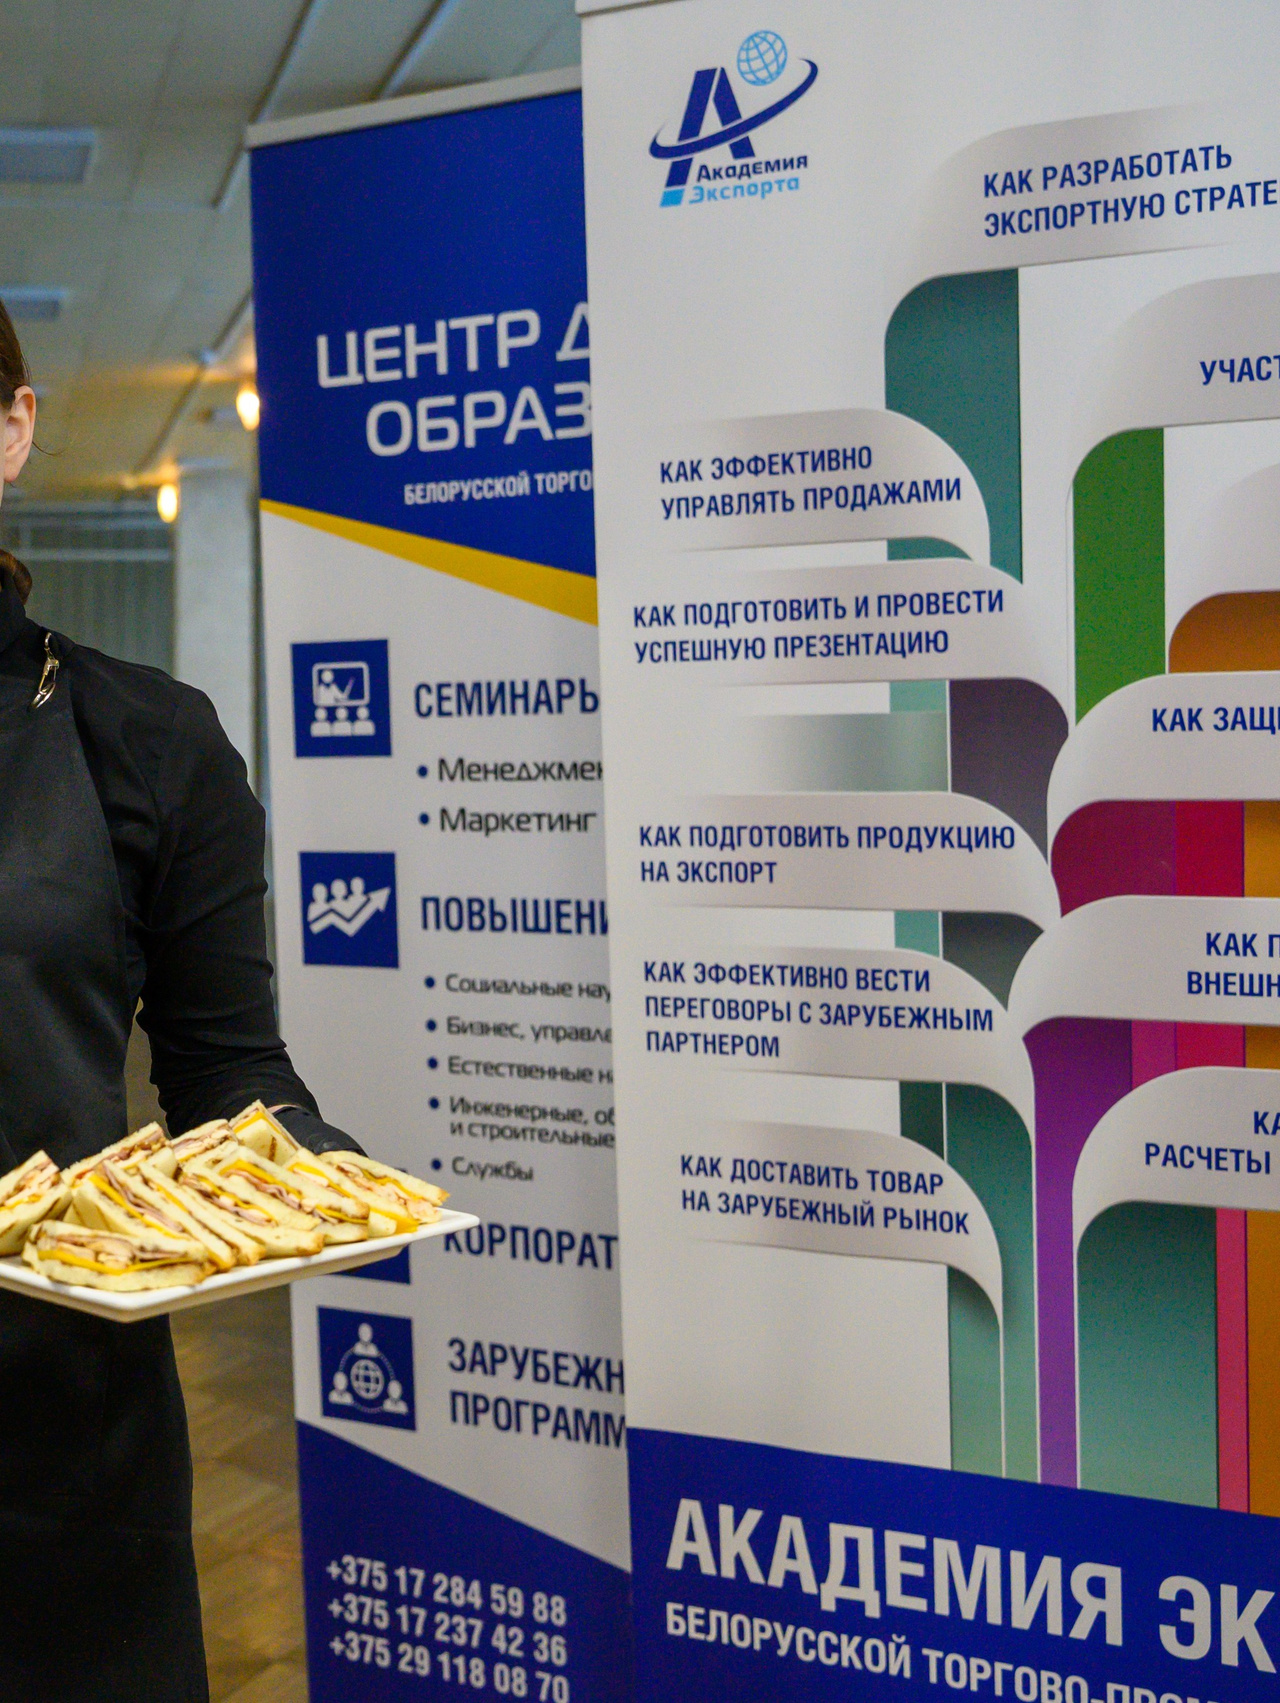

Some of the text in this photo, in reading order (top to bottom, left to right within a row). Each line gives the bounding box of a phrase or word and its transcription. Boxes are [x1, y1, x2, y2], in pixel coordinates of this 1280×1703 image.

[697, 155, 809, 183] Академия
[983, 144, 1233, 198] КАК РАЗРАБОТАТЬ
[688, 176, 800, 205] Экспорта
[983, 179, 1278, 238] ЭКСПОРТНУЮ СТРАТЕ
[316, 308, 541, 389] ЦЕНТР
[366, 381, 592, 457] ОБРАЗ
[660, 446, 873, 484] КАК ЭФФЕКТИВНО
[404, 468, 592, 506] БЕЛОРУССКОЙ ТОРГО
[661, 477, 962, 520] УПРАВЛЯТЬ ПРОДАЖАМИ
[633, 589, 1004, 630] КАК ПОДГОТОВИТЬ И ПРОВЕСТИ
[634, 630, 949, 664] УСПЕШНУЮ ПРЕЗЕНТАЦИЮ
[414, 677, 600, 719] СЕМИНАРЬ
[1152, 705, 1280, 736] КАК ЗАЩ
[439, 806, 597, 838] Маркетинг
[639, 825, 1016, 854] КАК ПОДГОТОВИТЬ ПРОДУКЦИЮ
[640, 861, 777, 884] НА ЭКСПОРТ
[1205, 932, 1258, 957] КАК
[445, 973, 573, 997] Социальные
[643, 961, 931, 993] КАК ЭФФЕКТИВНО ВЕСТИ
[1187, 971, 1280, 998] ВНЕШН
[645, 996, 994, 1032] ПЕРЕГОВОРЫ С ЗАРУБЕЖНЫМ
[646, 1031, 780, 1058] ПАРТНЕРОМ
[448, 1056, 593, 1083] Естественные
[450, 1122, 615, 1149] и строительные
[452, 1156, 534, 1181] Службы
[680, 1154, 944, 1196] КАК ДОСТАВИТЬ ТОВАР
[1144, 1143, 1271, 1175] РАСЧЕТЫ
[681, 1190, 970, 1235] НА ЗАРУБЕЖНЫЙ РЫНОК
[448, 1337, 625, 1395] ЗАРУБЕЖН
[450, 1390, 626, 1449] ПРОГРАММ
[326, 1554, 567, 1627] +375 17 284 59 88
[665, 1497, 1278, 1674] АКАДЕМИЯ ЭК
[327, 1592, 568, 1667] +375 17 237 42 36
[666, 1601, 911, 1679] БЕЛОРУССКОЙ
[329, 1630, 570, 1703] +375 29 118 08 70
